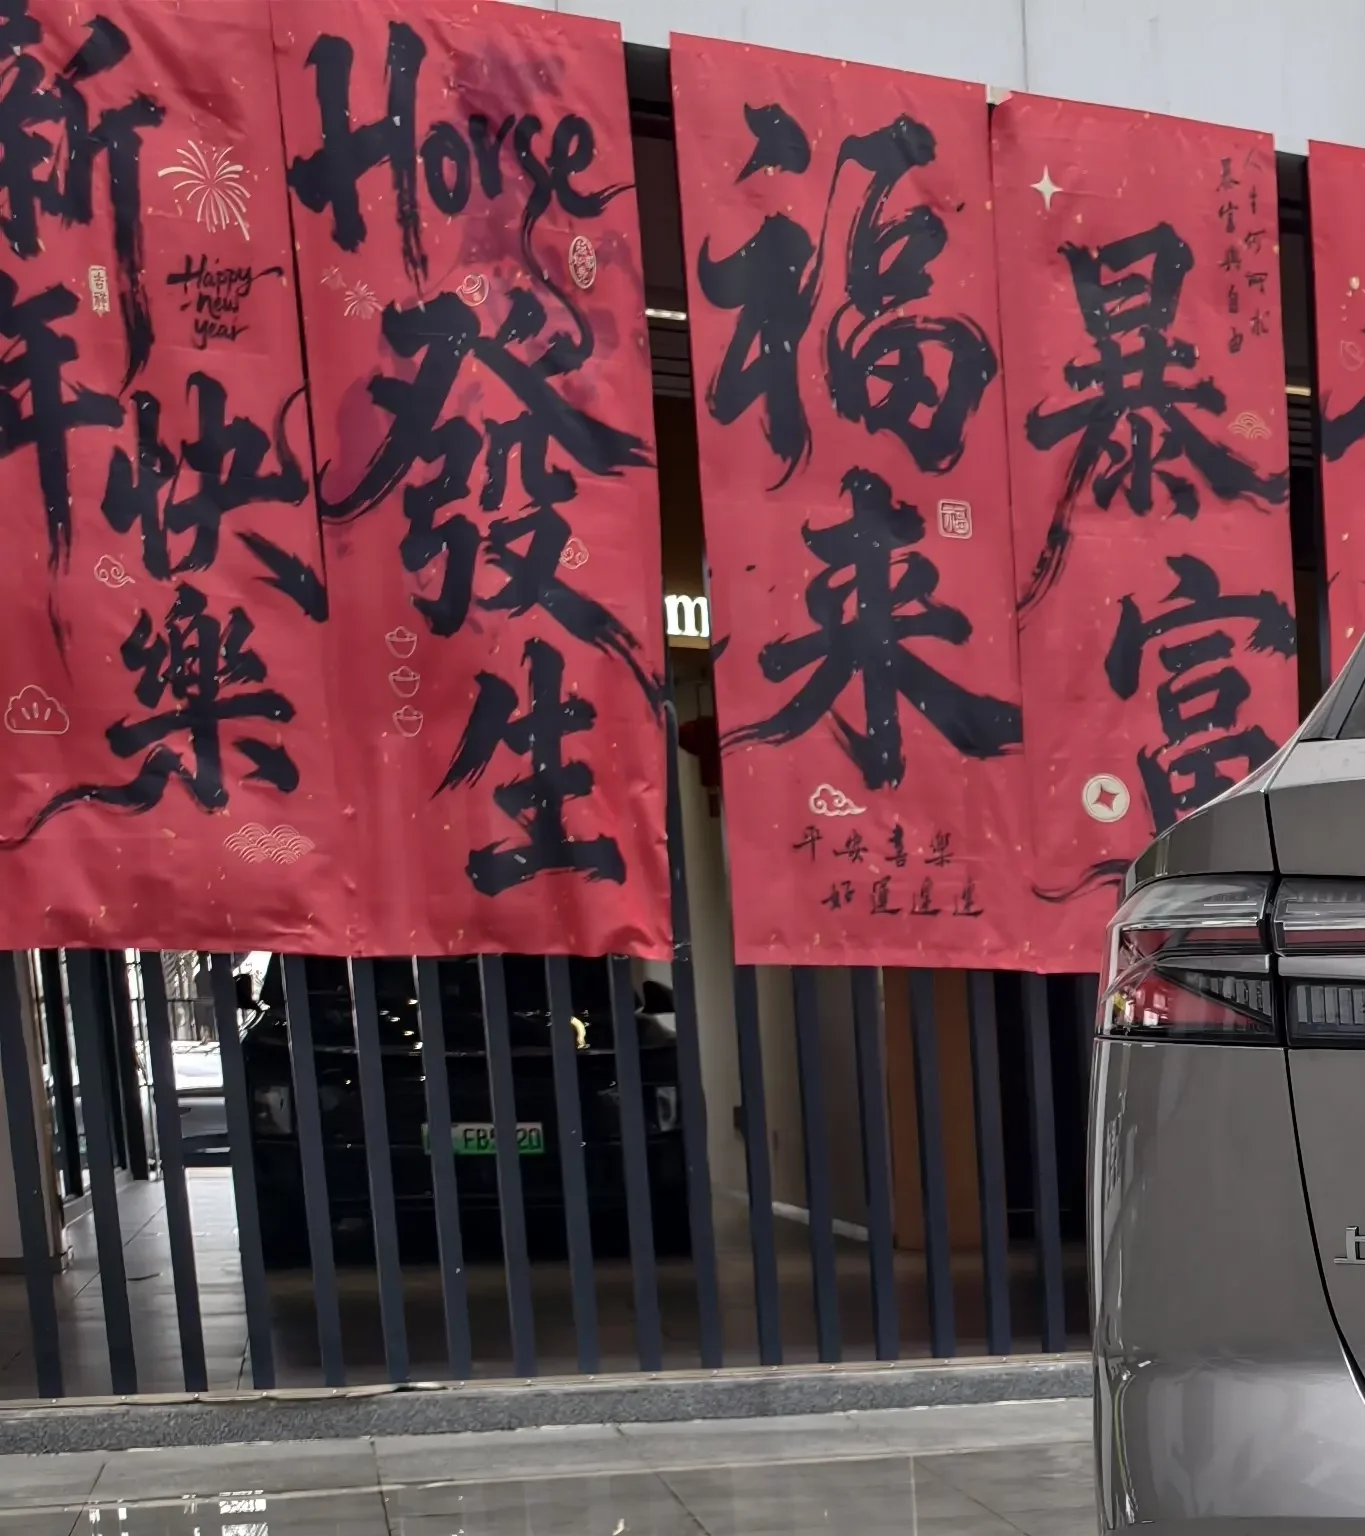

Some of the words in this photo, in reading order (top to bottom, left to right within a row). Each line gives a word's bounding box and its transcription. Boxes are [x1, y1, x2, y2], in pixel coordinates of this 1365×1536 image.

[288, 20, 635, 295] Horse
[167, 254, 284, 297] Happy
[191, 318, 250, 350] year
